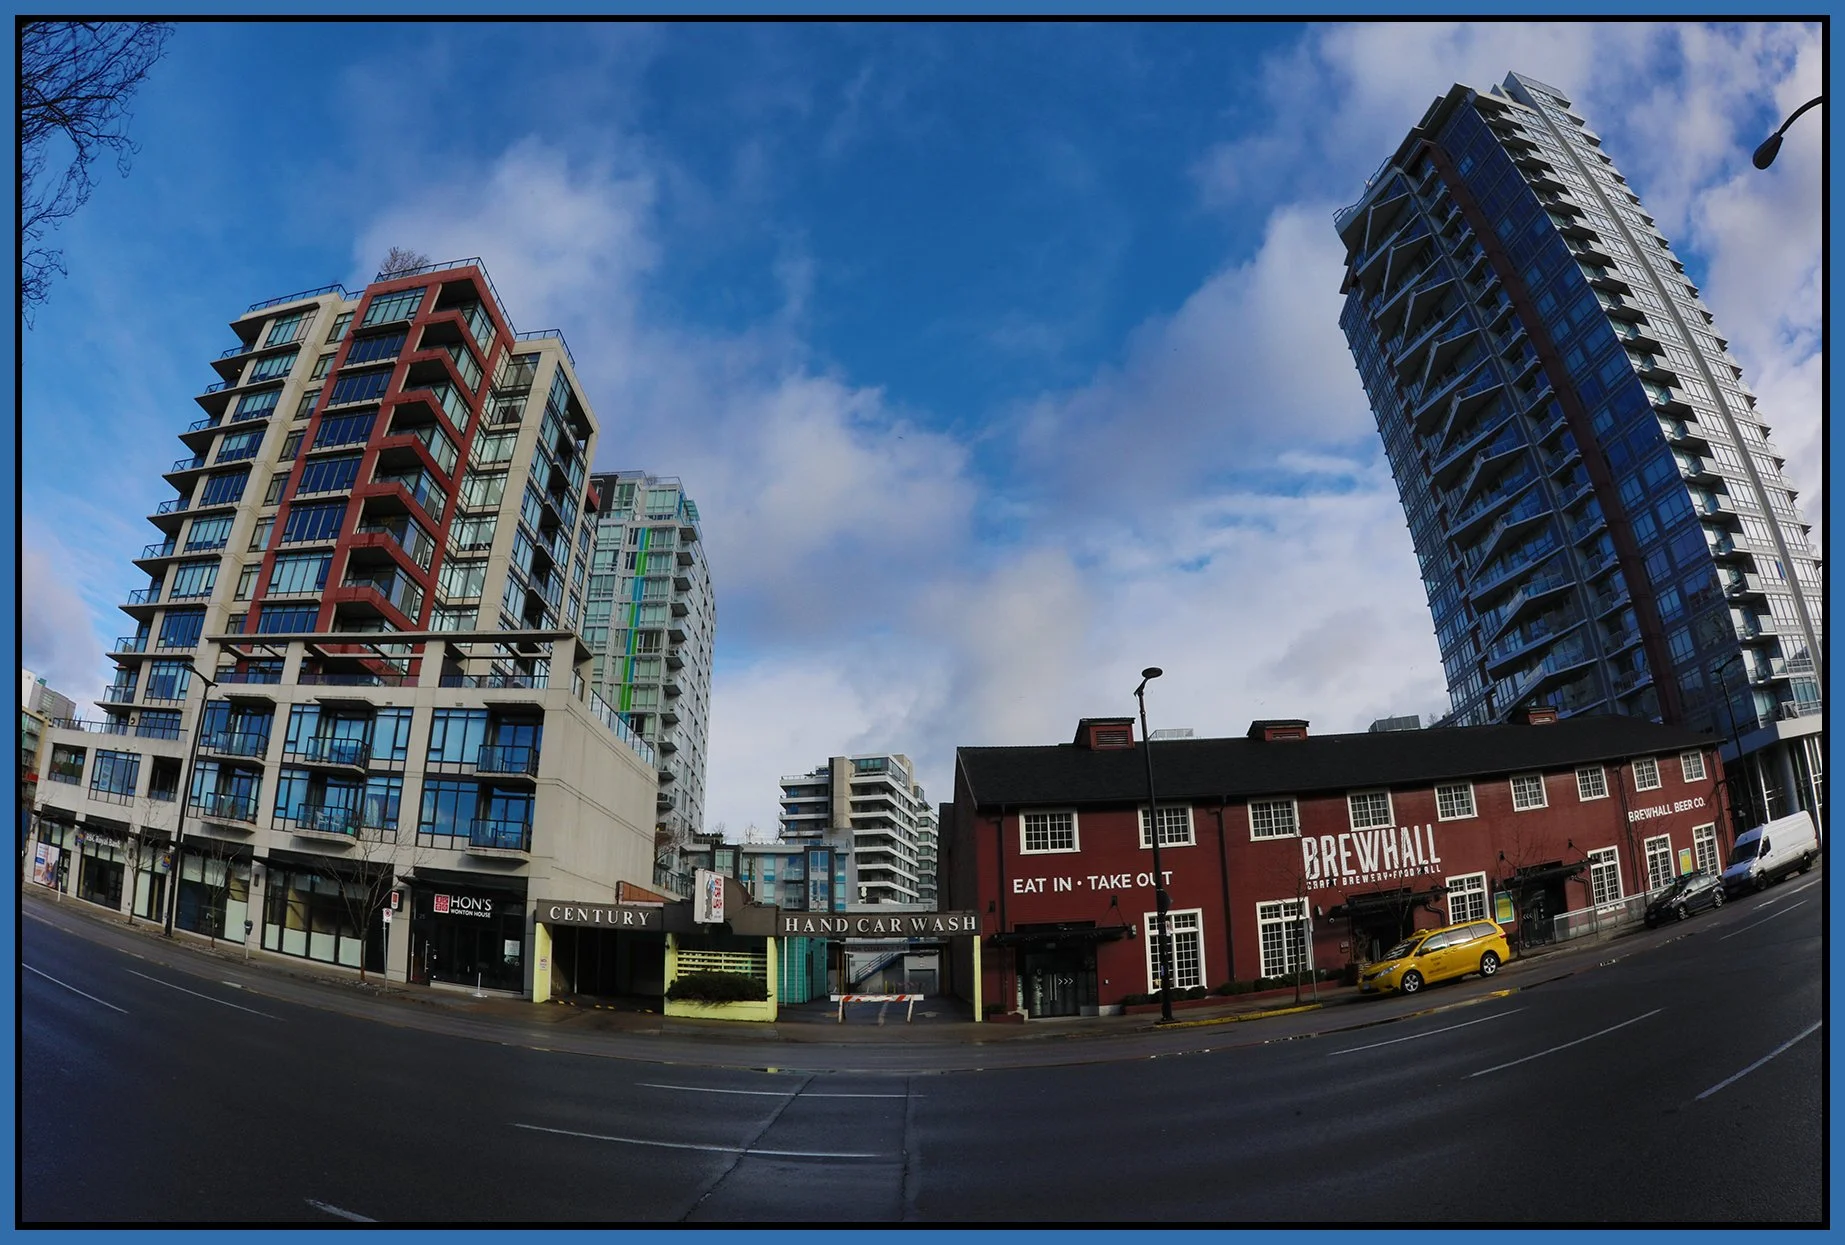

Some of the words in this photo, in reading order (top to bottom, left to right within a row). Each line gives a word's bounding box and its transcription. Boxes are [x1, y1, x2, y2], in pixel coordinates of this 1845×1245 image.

[1628, 804, 1673, 822] BREWHALL
[1674, 799, 1693, 813] BEER
[1693, 797, 1706, 808] CO.
[1302, 823, 1441, 880] BREWHALL
[1013, 878, 1047, 894] EAT
[1053, 877, 1072, 892] IN
[1087, 874, 1132, 890] TAKE
[1306, 878, 1337, 890] CRAFT
[1342, 873, 1388, 887] BREWERY
[450, 895, 492, 911] HON'S
[450, 908, 473, 916] WONTON
[473, 910, 491, 918] HOUSE
[549, 906, 650, 926] CENTURY
[785, 917, 849, 933] HAND
[856, 918, 902, 933] CAR
[911, 916, 976, 933] WASH
